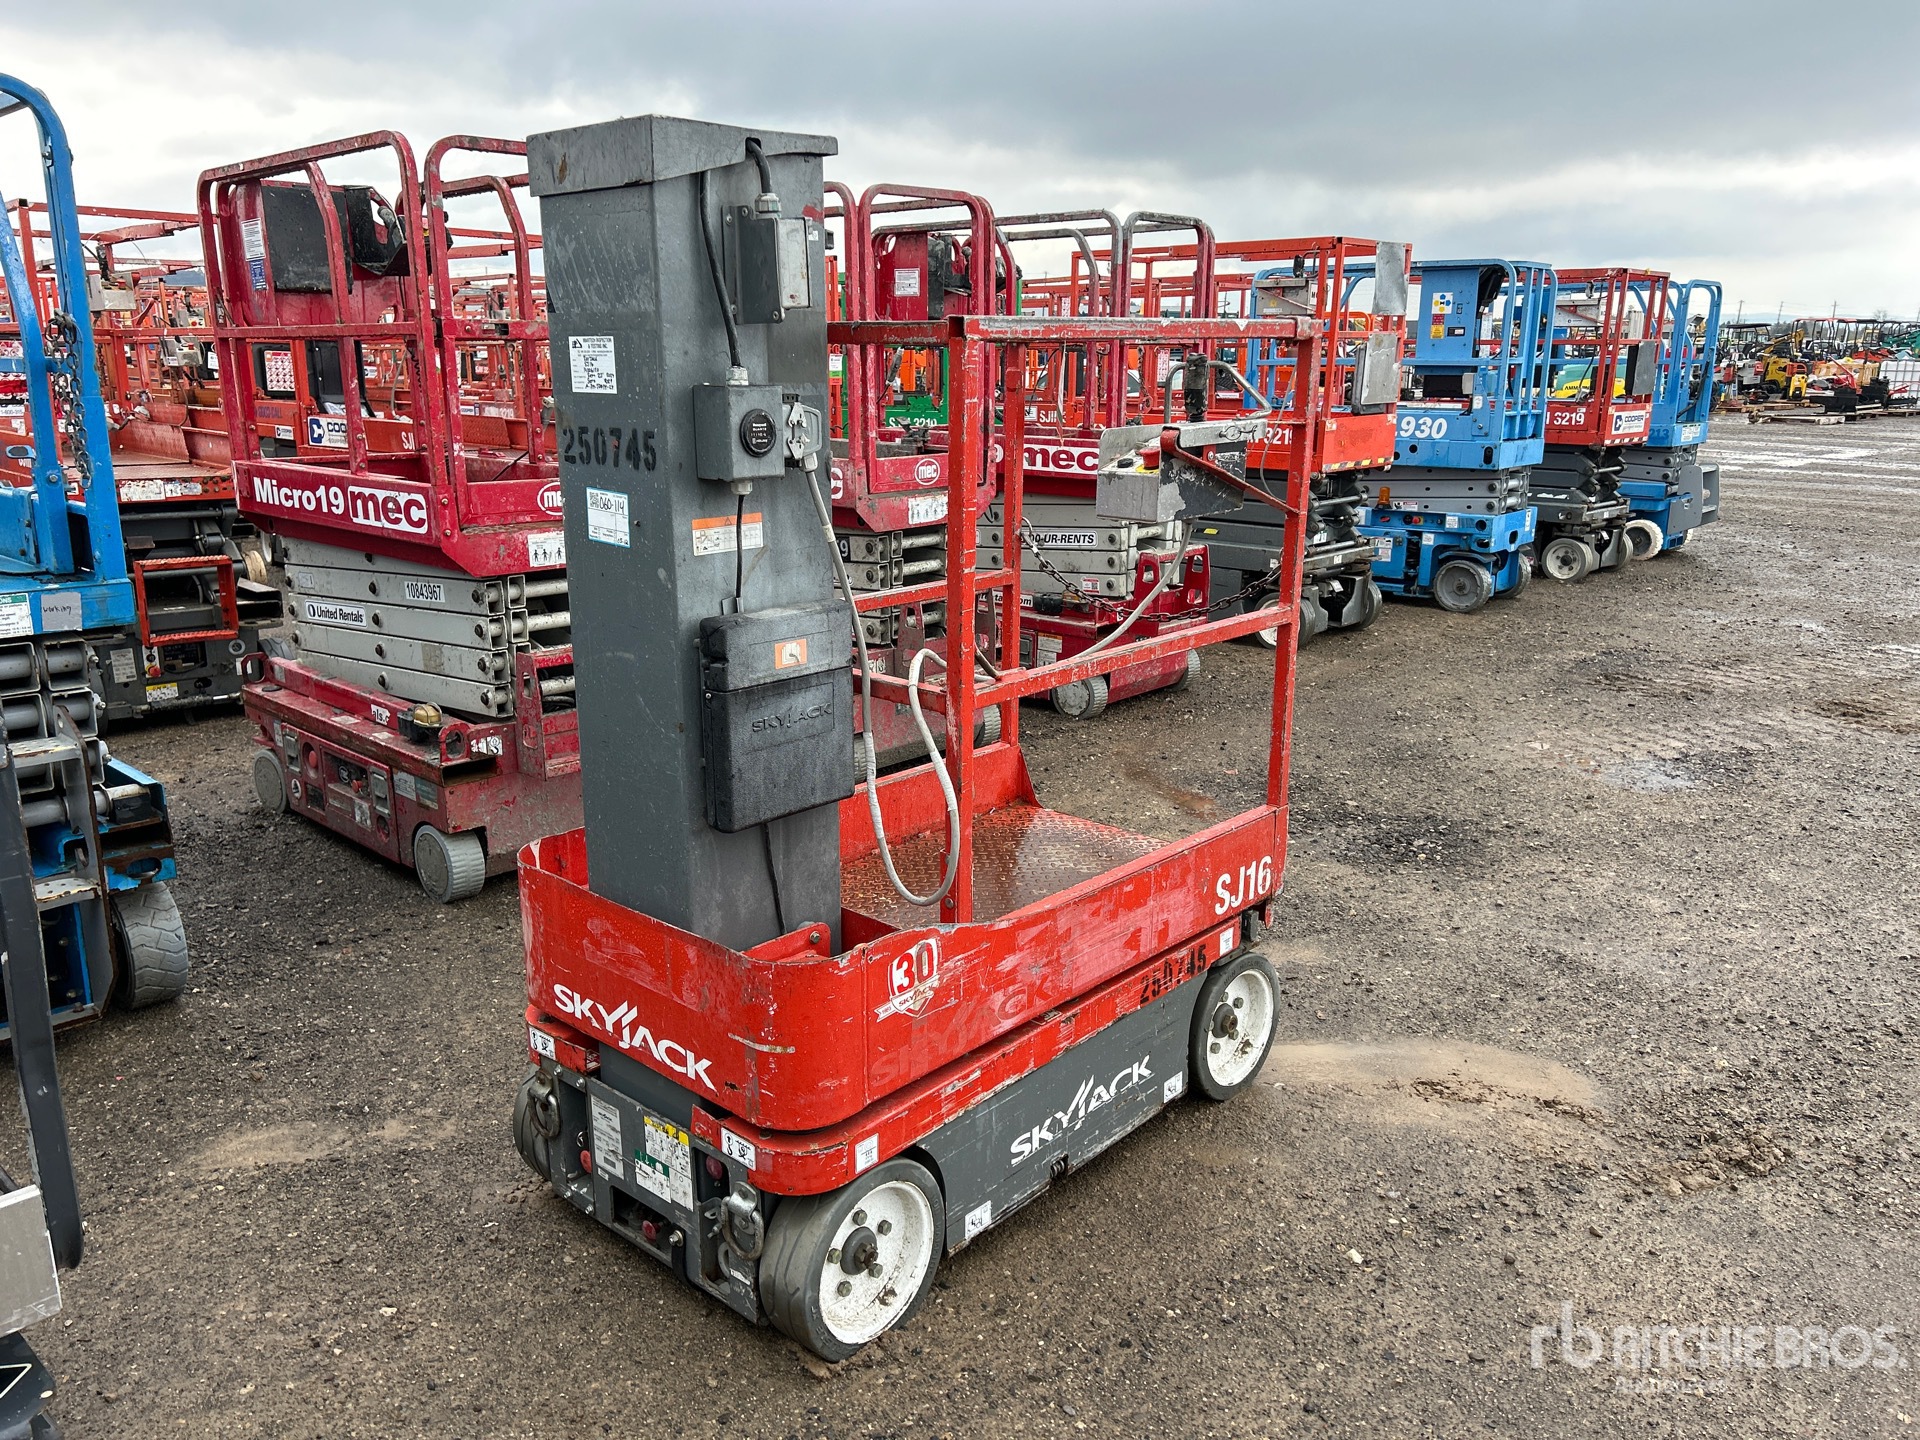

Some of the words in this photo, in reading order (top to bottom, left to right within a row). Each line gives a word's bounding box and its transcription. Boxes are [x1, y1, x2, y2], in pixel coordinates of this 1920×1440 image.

[1394, 415, 1448, 439] 930
[1553, 411, 1585, 426] 3219
[562, 425, 658, 472] 250745
[253, 476, 345, 515] Micro19
[350, 490, 427, 528] mec
[599, 496, 625, 515] 060-114
[316, 606, 338, 621] United
[338, 609, 364, 624] Rentals
[406, 582, 442, 602] 10843967
[751, 701, 834, 733] SKYJACK
[1214, 855, 1273, 916] SJ16
[896, 942, 935, 995] 30
[1139, 943, 1208, 1005] 250745
[553, 983, 721, 1098] SKYJACK
[1010, 1054, 1154, 1168] SKYJACK
